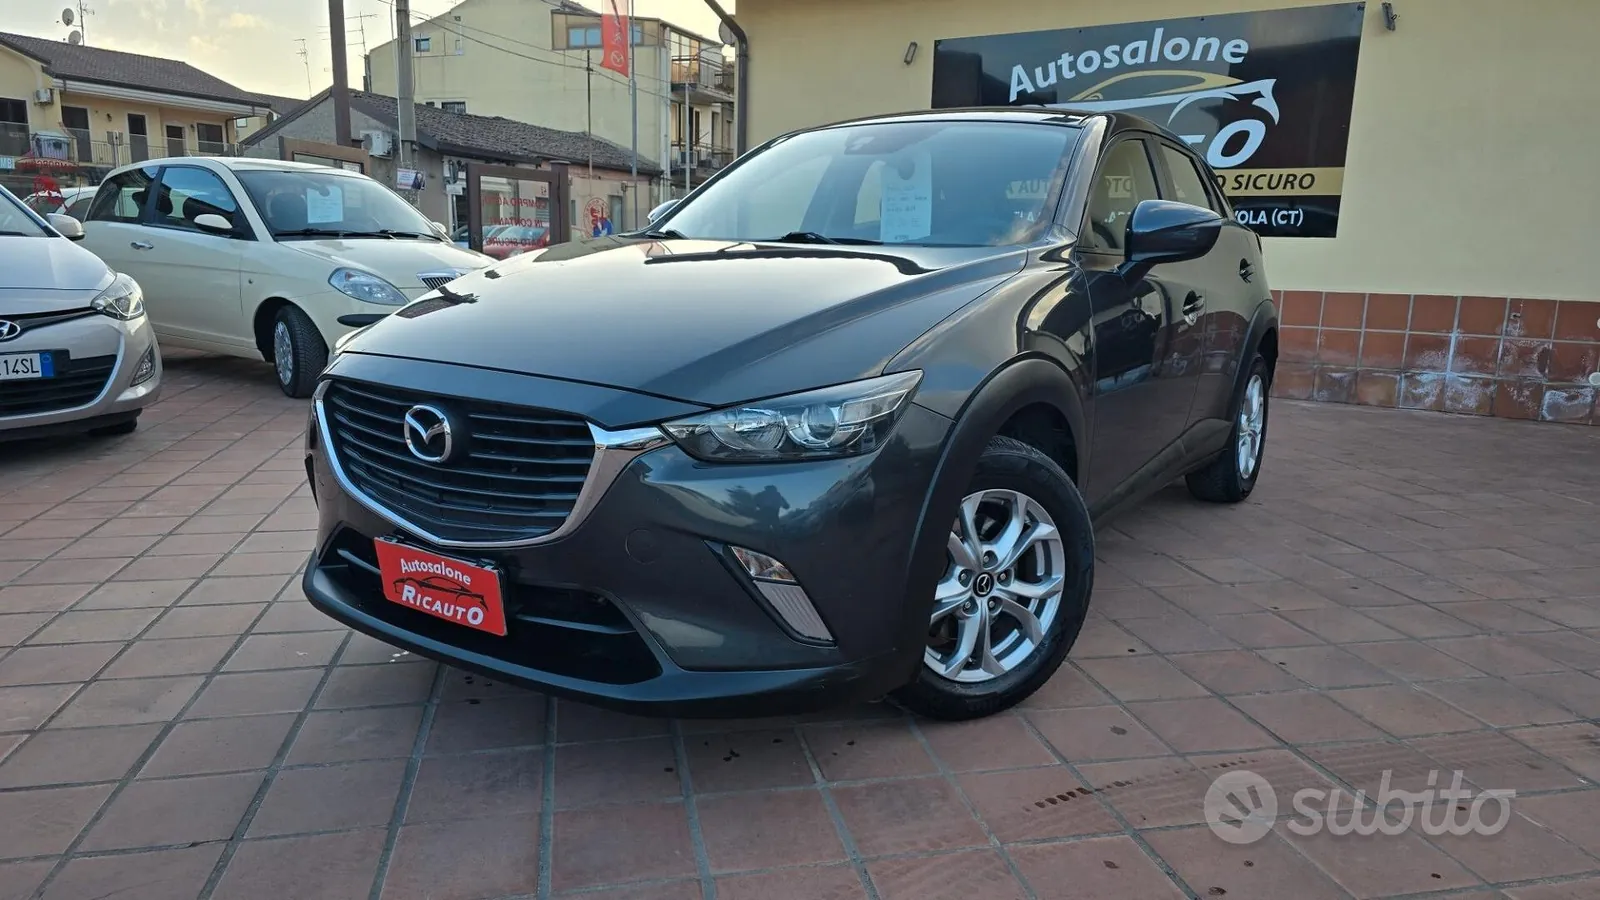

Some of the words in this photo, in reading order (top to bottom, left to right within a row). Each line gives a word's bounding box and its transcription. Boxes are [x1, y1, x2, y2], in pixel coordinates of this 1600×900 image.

[1009, 28, 1249, 103] Autosalone
[1231, 173, 1316, 191] SICURO
[1272, 208, 1304, 227] (CT)
[0, 358, 40, 376] 14SL
[400, 558, 471, 585] Autosalone
[401, 584, 484, 625] RICAUTO
